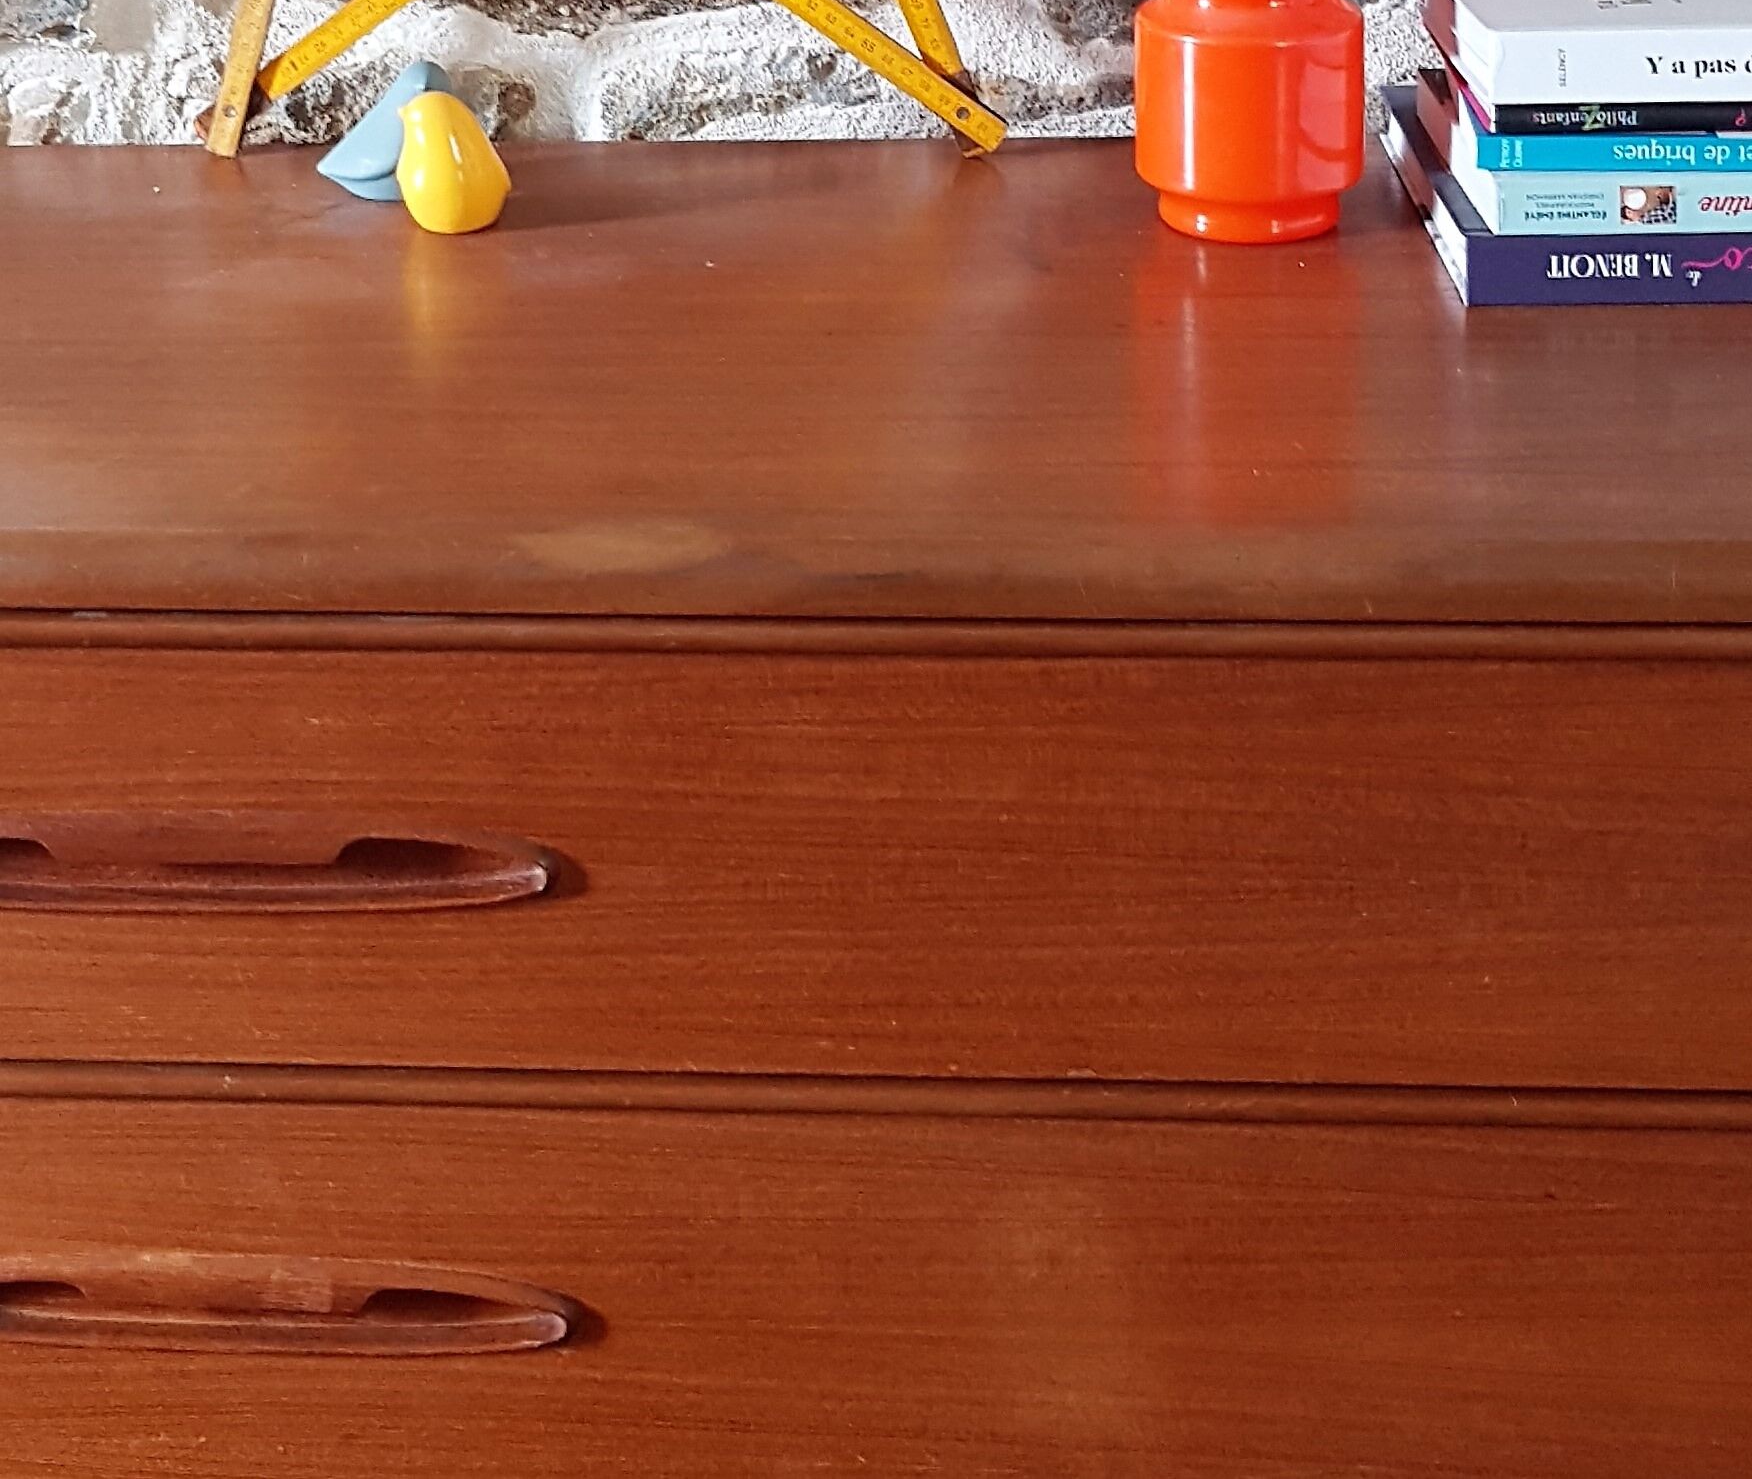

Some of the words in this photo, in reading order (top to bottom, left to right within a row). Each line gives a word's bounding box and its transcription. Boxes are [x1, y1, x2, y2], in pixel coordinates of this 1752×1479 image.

[1645, 56, 1663, 75] Y
[1671, 60, 1686, 74] a
[1693, 59, 1736, 79] pas
[1613, 139, 1696, 165] briques
[1704, 145, 1730, 165] de
[1545, 253, 1641, 280] BENOIT
[1644, 253, 1673, 279] M.
